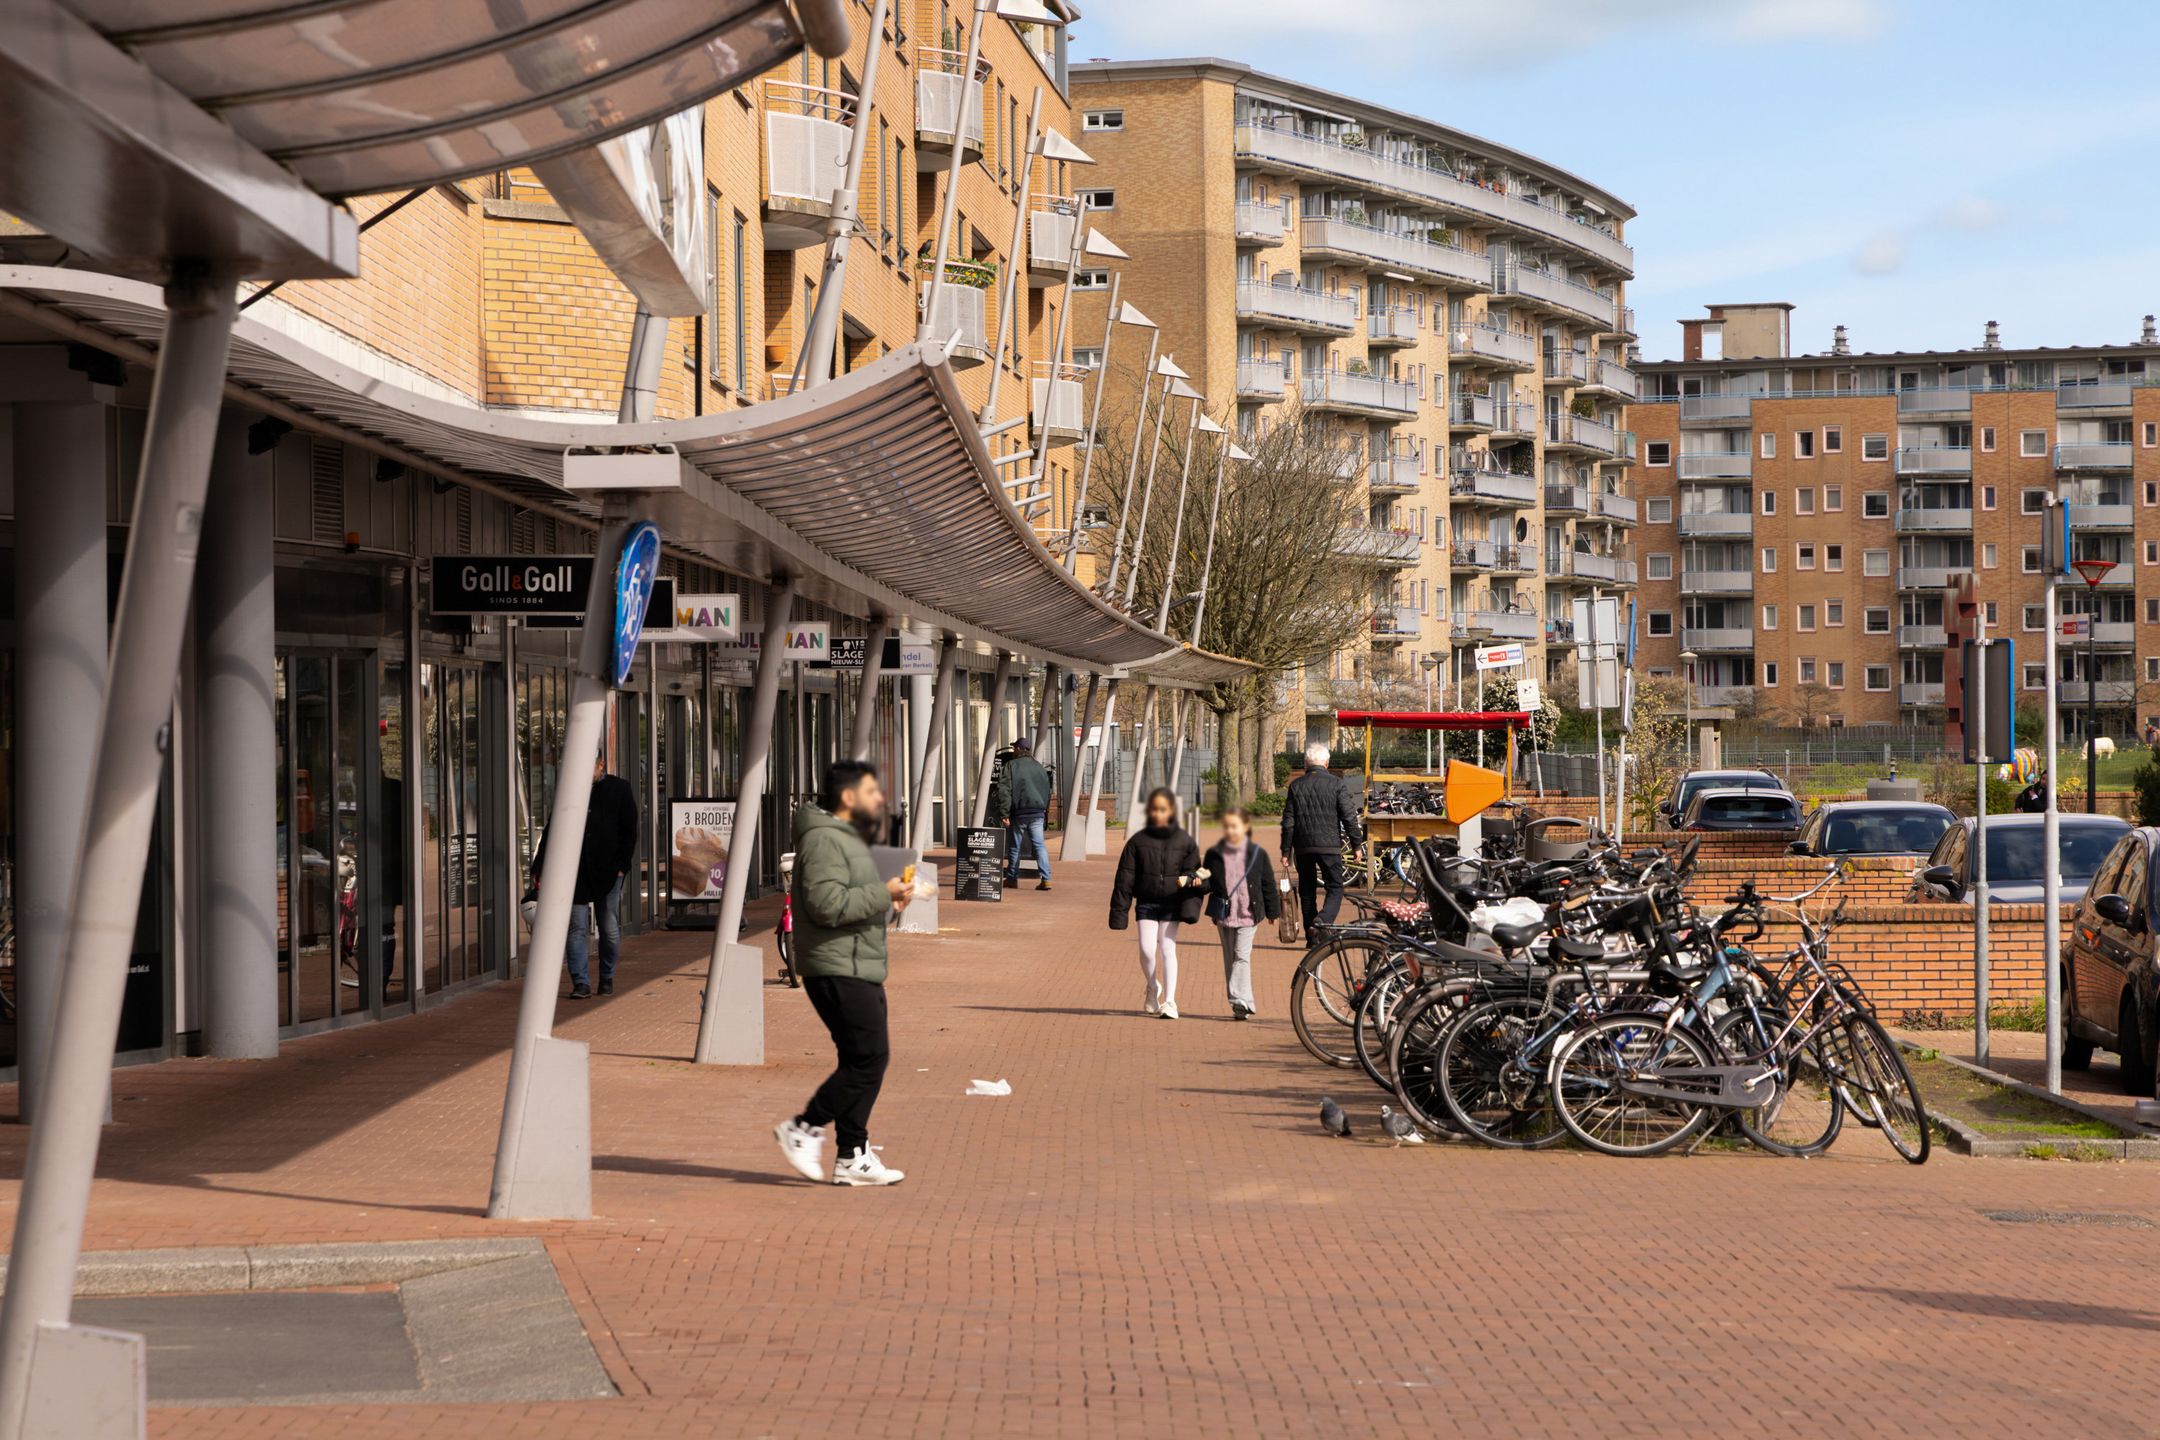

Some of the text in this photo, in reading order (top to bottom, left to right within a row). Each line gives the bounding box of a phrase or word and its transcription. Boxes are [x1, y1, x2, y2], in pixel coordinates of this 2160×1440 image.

[831, 650, 866, 659] SLAGE
[684, 812, 735, 826] 3 BRODEN
